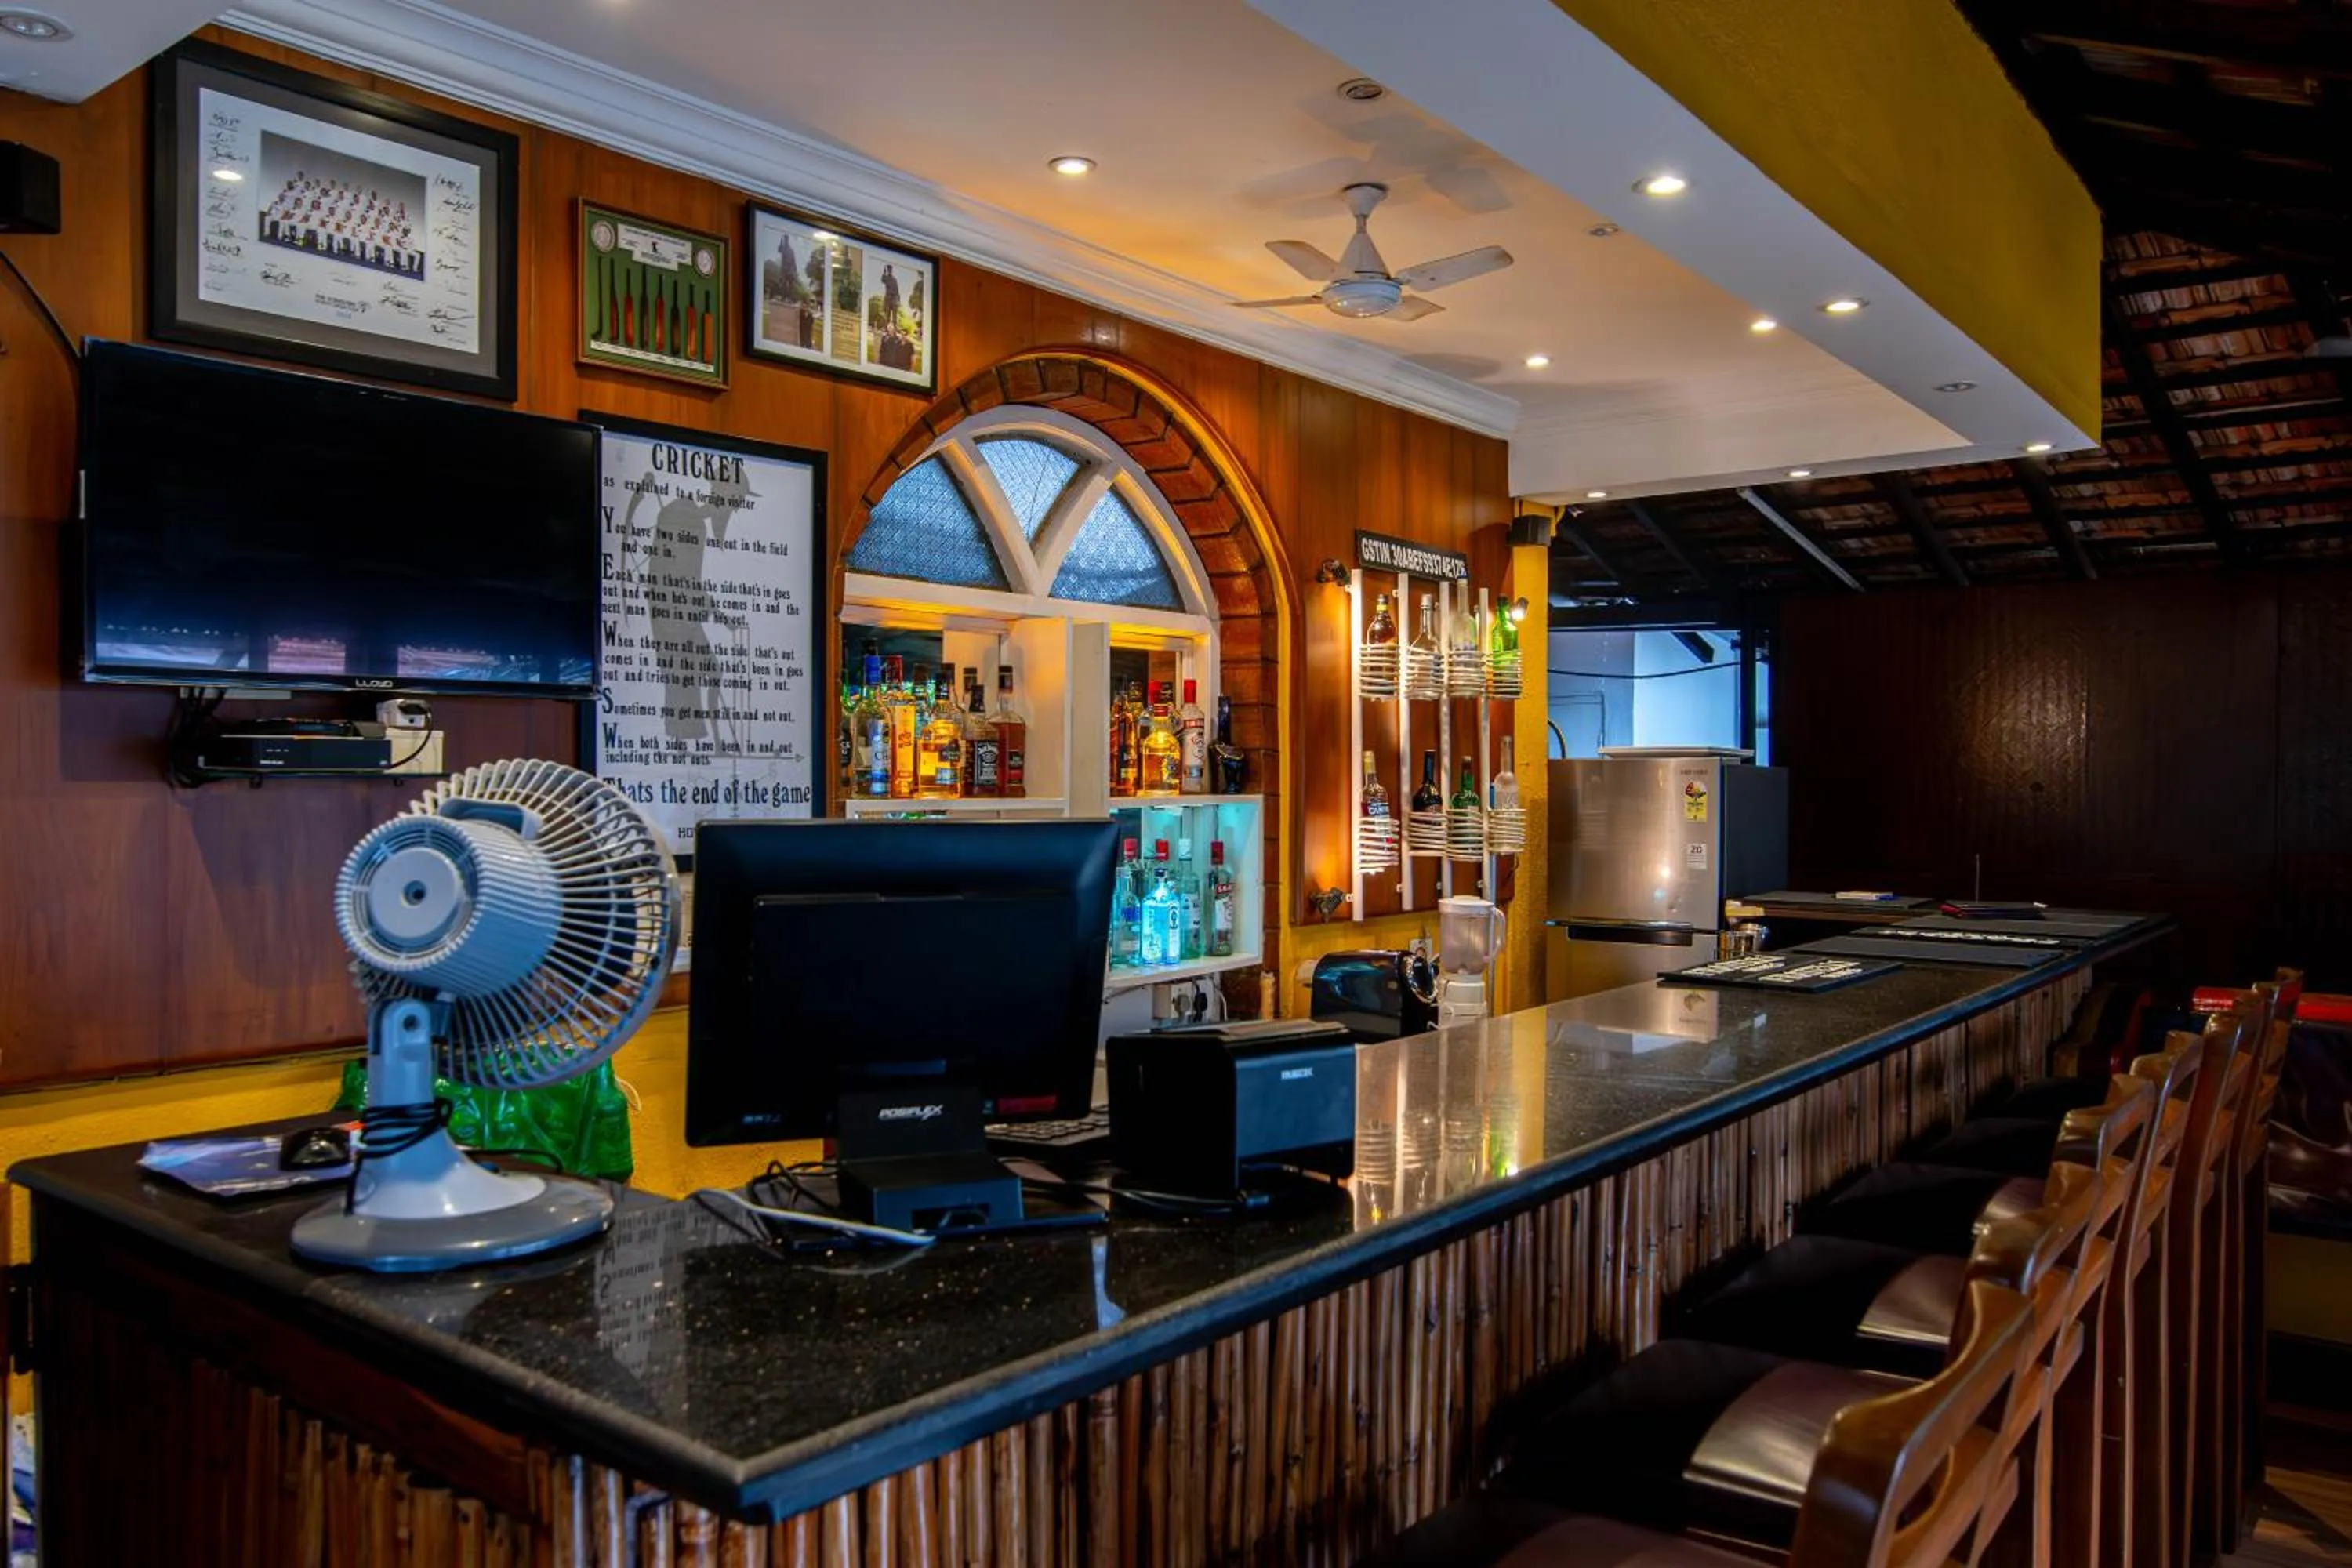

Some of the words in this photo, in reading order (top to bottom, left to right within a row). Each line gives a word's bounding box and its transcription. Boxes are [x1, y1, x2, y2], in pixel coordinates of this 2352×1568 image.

[652, 443, 744, 484] CRICKET
[604, 476, 615, 488] as
[624, 479, 669, 497] explained
[685, 491, 694, 502] a
[696, 488, 725, 508] foreign
[728, 495, 756, 510] visitor
[602, 506, 626, 534] You
[631, 523, 651, 539] have
[656, 527, 673, 541] two
[677, 530, 699, 546] sides
[724, 539, 737, 550] out
[741, 538, 750, 552] in
[753, 539, 766, 554] the
[769, 542, 788, 557] field
[621, 540, 637, 553] and
[642, 544, 658, 556] one
[1361, 537, 1392, 564] GSTIN
[602, 552, 633, 583] Each
[639, 573, 657, 585] man
[663, 573, 690, 590] that's
[692, 576, 702, 590] in
[703, 579, 717, 593] the
[720, 580, 737, 593] side
[739, 583, 761, 597] that's
[763, 585, 771, 598] in
[774, 588, 791, 601] goes
[602, 603, 620, 614] next
[626, 604, 645, 615] man
[652, 606, 670, 619] goes
[673, 605, 684, 619] in
[603, 586, 617, 597] out
[622, 586, 639, 599] and
[644, 589, 666, 602] when
[672, 590, 688, 604] he's
[692, 596, 705, 608] out
[710, 596, 720, 608] he
[722, 599, 747, 611] comes
[752, 598, 761, 612] in
[765, 601, 780, 613] and
[786, 603, 800, 615] the
[602, 619, 634, 648] When
[641, 635, 661, 652] they
[664, 641, 678, 652] are
[681, 640, 693, 652] all
[695, 643, 710, 655] out
[714, 641, 728, 655] the
[731, 644, 748, 657] side
[755, 644, 778, 659] that's
[782, 648, 795, 660] out
[604, 654, 633, 665] comes
[639, 652, 648, 666] in
[657, 655, 673, 669] and
[680, 657, 694, 670] the
[699, 659, 717, 671] side
[720, 659, 746, 673] that's
[752, 661, 770, 676] been
[775, 662, 784, 676] in
[786, 666, 804, 679] goes
[603, 670, 618, 681] out
[625, 669, 642, 681] and
[646, 670, 670, 684] tries
[671, 671, 680, 684] to
[682, 675, 694, 688] get
[699, 675, 720, 688] those
[724, 675, 751, 692] coming
[759, 677, 768, 690] in
[601, 687, 656, 716] Sometimes
[660, 706, 674, 718] you
[679, 706, 691, 720] get
[695, 709, 710, 719] men
[731, 706, 741, 720] in
[743, 708, 758, 720] and
[763, 709, 776, 721] not
[602, 722, 634, 749] When
[641, 735, 659, 750] both
[666, 738, 688, 750] sides
[695, 739, 713, 752] have
[720, 740, 741, 752] been
[746, 739, 754, 753] in
[759, 739, 774, 753] and
[779, 742, 793, 753] out
[605, 750, 650, 765] including
[653, 751, 668, 764] the
[672, 753, 687, 764] not
[661, 779, 686, 804] the
[692, 779, 719, 804] end
[724, 779, 739, 804] of
[744, 780, 768, 805] the
[772, 782, 811, 808] game
